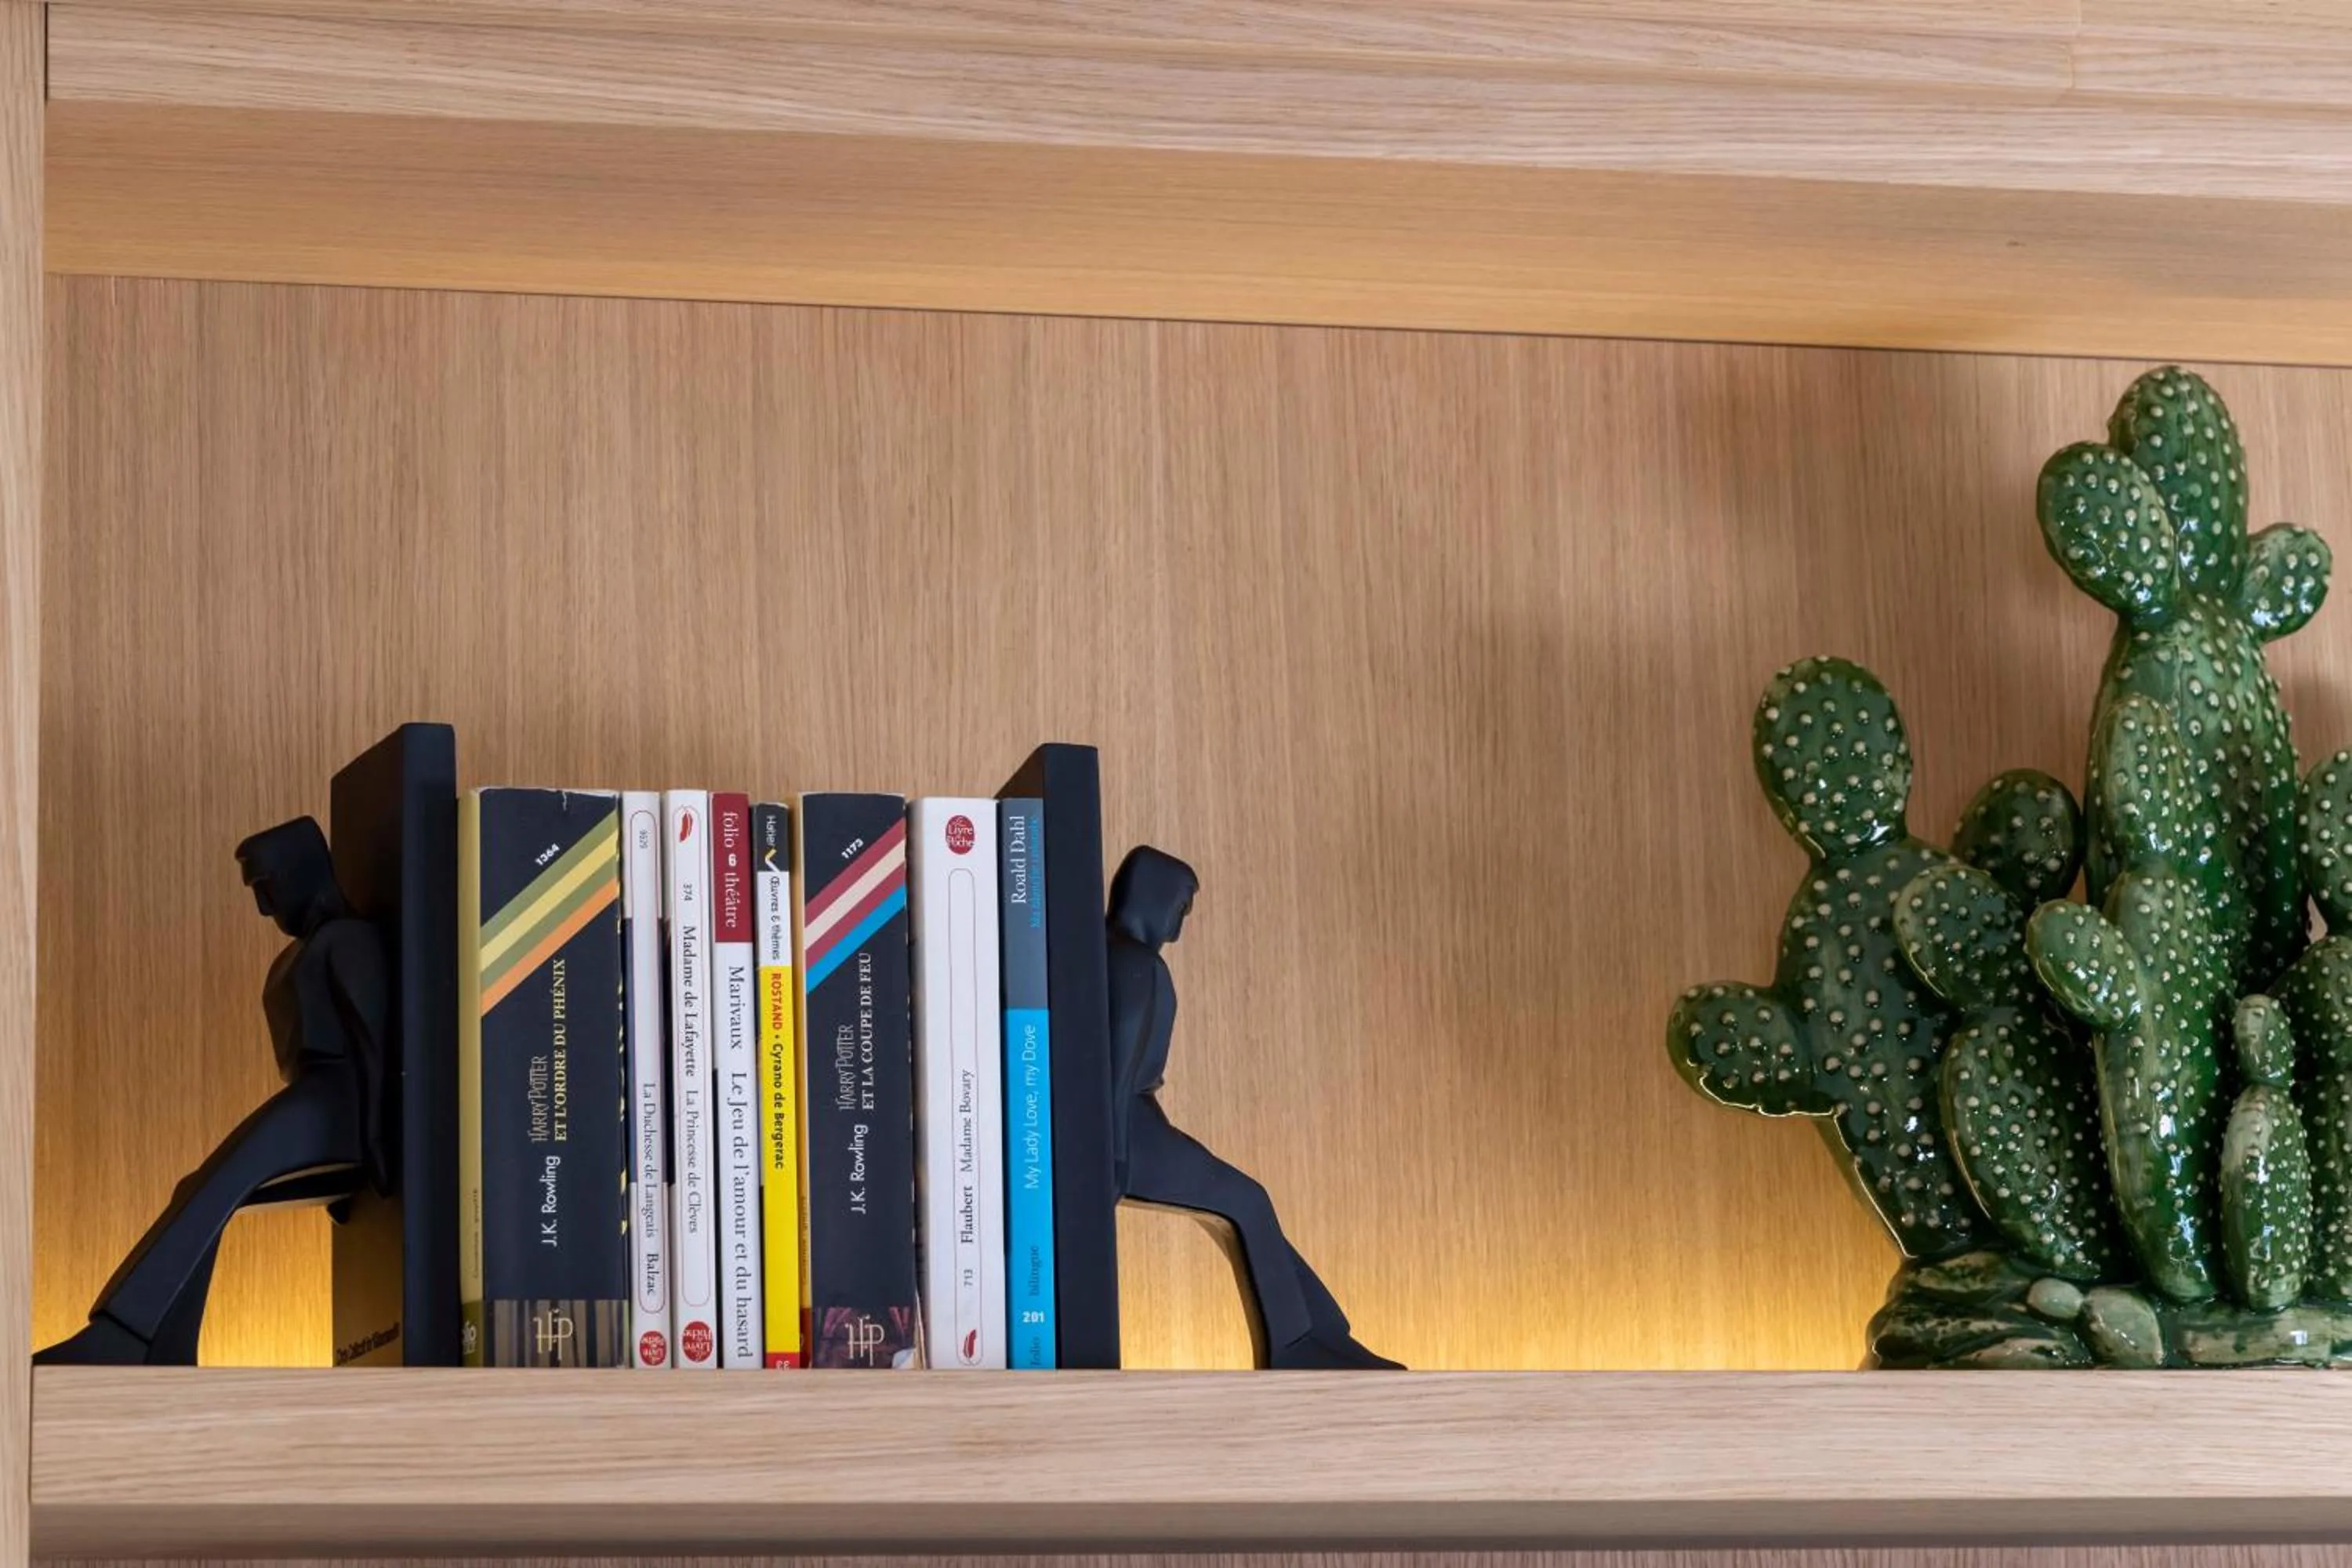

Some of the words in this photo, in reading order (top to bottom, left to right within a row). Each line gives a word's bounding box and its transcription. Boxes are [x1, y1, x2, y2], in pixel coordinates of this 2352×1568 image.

[722, 811, 739, 848] folio
[765, 815, 777, 846] Hatier
[1008, 815, 1026, 852] Dahl
[535, 843, 561, 866] 1364
[841, 838, 864, 859] 1173
[683, 884, 693, 902] 374
[1009, 858, 1026, 903] Roald
[724, 873, 740, 928] théâtre
[682, 926, 698, 987] Madame
[771, 924, 783, 960] thèmes
[858, 953, 872, 982] FEU
[550, 959, 565, 1019] PHÉNIX
[684, 992, 699, 1007] de
[771, 972, 782, 1030] ROSTAND
[860, 985, 873, 1007] DE
[728, 965, 746, 1050] Marivaux
[553, 1023, 566, 1046] DU
[681, 1013, 700, 1077] Lafayette
[835, 1024, 855, 1070] POTTER
[860, 1008, 873, 1063] COUPE
[1022, 1024, 1036, 1061] Dove
[528, 1055, 548, 1099] POTTER
[554, 1049, 567, 1118] L'ORDRE
[731, 1073, 747, 1095] Le
[770, 1043, 784, 1089] Cyrano
[862, 1065, 874, 1087] LA
[1025, 1064, 1040, 1087] my
[643, 1083, 656, 1098] La
[686, 1091, 699, 1105] La
[773, 1092, 786, 1109] de
[835, 1068, 858, 1112] HARRY
[862, 1090, 874, 1110] ET
[959, 1069, 975, 1113] Bovary
[528, 1101, 550, 1142] HARRY
[727, 1097, 748, 1130] Jeu
[1024, 1091, 1042, 1127] Love,
[554, 1123, 567, 1142] ET
[643, 1102, 658, 1161] Duchesse
[686, 1111, 699, 1167] Princesse
[733, 1136, 749, 1159] de
[771, 1112, 785, 1170] Bergerac
[959, 1117, 973, 1172] Madame
[1023, 1131, 1041, 1163] Lady
[848, 1124, 869, 1181] Rowling
[539, 1155, 561, 1214] Rowling
[645, 1164, 659, 1180] de
[688, 1172, 701, 1188] de
[1023, 1166, 1042, 1189] My
[641, 1184, 659, 1238] Langeais
[688, 1192, 702, 1234] Clèves
[733, 1165, 750, 1238] l'amour
[850, 1186, 866, 1214] J.K.
[959, 1185, 974, 1243] Flaubert
[541, 1219, 557, 1247] J.K.
[735, 1243, 748, 1261] et
[646, 1253, 659, 1296] Balzac
[735, 1266, 752, 1290] du
[964, 1269, 974, 1287] 713
[1029, 1246, 1042, 1296] bilingue
[736, 1297, 753, 1358] hasard
[1022, 1311, 1045, 1323] 201
[1030, 1336, 1041, 1367] folio
